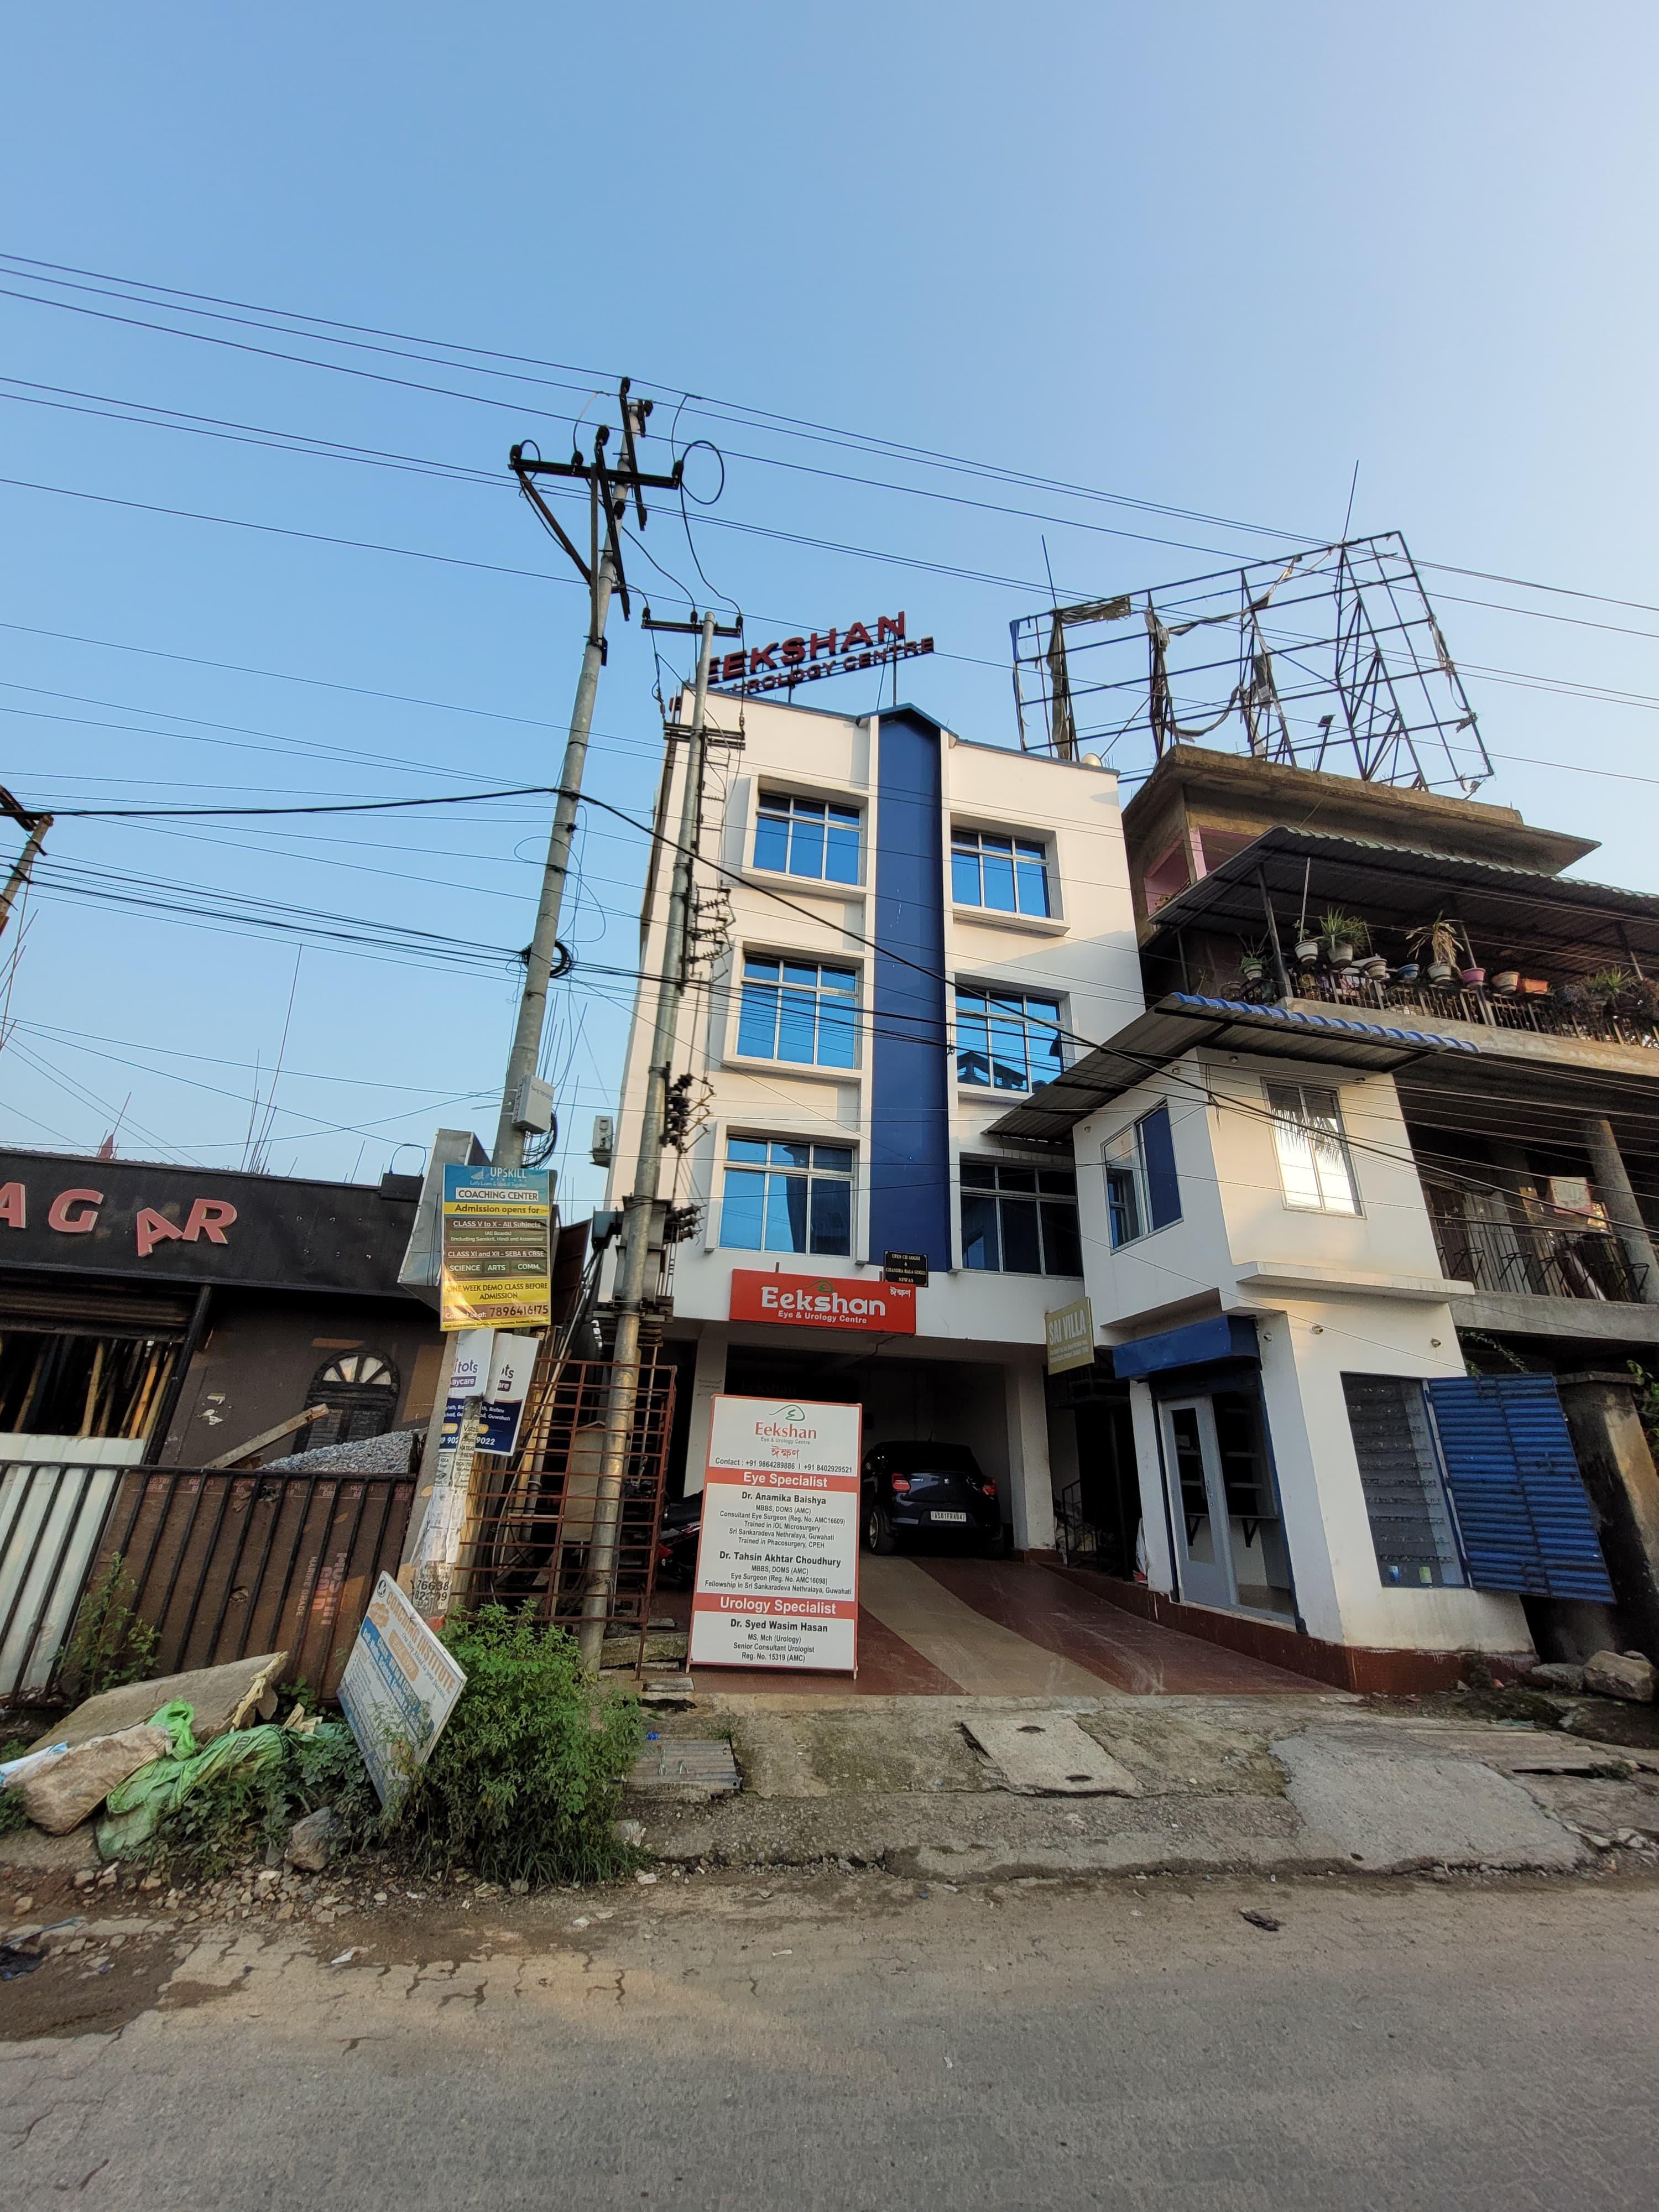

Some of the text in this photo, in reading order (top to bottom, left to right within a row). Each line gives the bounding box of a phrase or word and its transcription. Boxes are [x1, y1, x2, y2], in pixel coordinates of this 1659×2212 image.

[843, 637, 934, 672] CENTRE
[491, 1167, 526, 1178] UPSKILL
[458, 1190, 538, 1200] COACHING CENTER
[455, 1204, 500, 1213] Admission
[502, 1206, 526, 1214] opens
[760, 1286, 885, 1316] Eekshan
[778, 1310, 793, 1319] Eye
[805, 1312, 837, 1323] Urology
[839, 1314, 867, 1324] Centre
[1062, 1309, 1087, 1340] VILLA
[754, 1421, 817, 1439] Eekshan
[715, 1457, 740, 1466] Contact
[758, 1460, 795, 1469] 9864289886
[816, 1464, 853, 1473] 8402929521
[743, 1472, 828, 1488] Eye Specialist
[742, 1491, 826, 1505] Dr. Anamika Baishya
[719, 1510, 750, 1520] Consultant
[763, 1513, 787, 1522] Surgeon
[788, 1515, 802, 1524] (Reg.
[755, 1505, 774, 1513] MBBS,
[794, 1506, 811, 1515] (AMC)
[738, 1528, 774, 1537] Sankaradeva
[776, 1530, 807, 1540] Nethralaya,
[784, 1523, 821, 1533] Microsurgery
[767, 1539, 807, 1548] Phacosurgery,
[719, 1551, 841, 1568] Dr. Tahsin Akhtar Choudhury
[751, 1565, 771, 1573] MBBS,
[791, 1567, 808, 1575] (AMC)
[743, 1573, 767, 1583] Surgeon
[769, 1575, 784, 1584] (Reg.
[296, 1556, 317, 1616] MARINE GRADE
[705, 1580, 736, 1589] Fellowship
[754, 1583, 790, 1592] Sankaradeva
[792, 1585, 824, 1594] Nethralaya,
[720, 1597, 836, 1615] Urology Specialist
[731, 1619, 828, 1632] Dr. Syed Wasim Hasan
[387, 1592, 420, 1642] COACHING
[417, 1635, 456, 1694] INSTITUTE
[748, 1634, 759, 1642] MS,
[774, 1635, 801, 1644] (Urology)
[754, 1644, 786, 1652] Consultant
[787, 1645, 815, 1653] Urologist
[742, 1652, 755, 1661] Reg.
[787, 1655, 805, 1663] (AMC)
